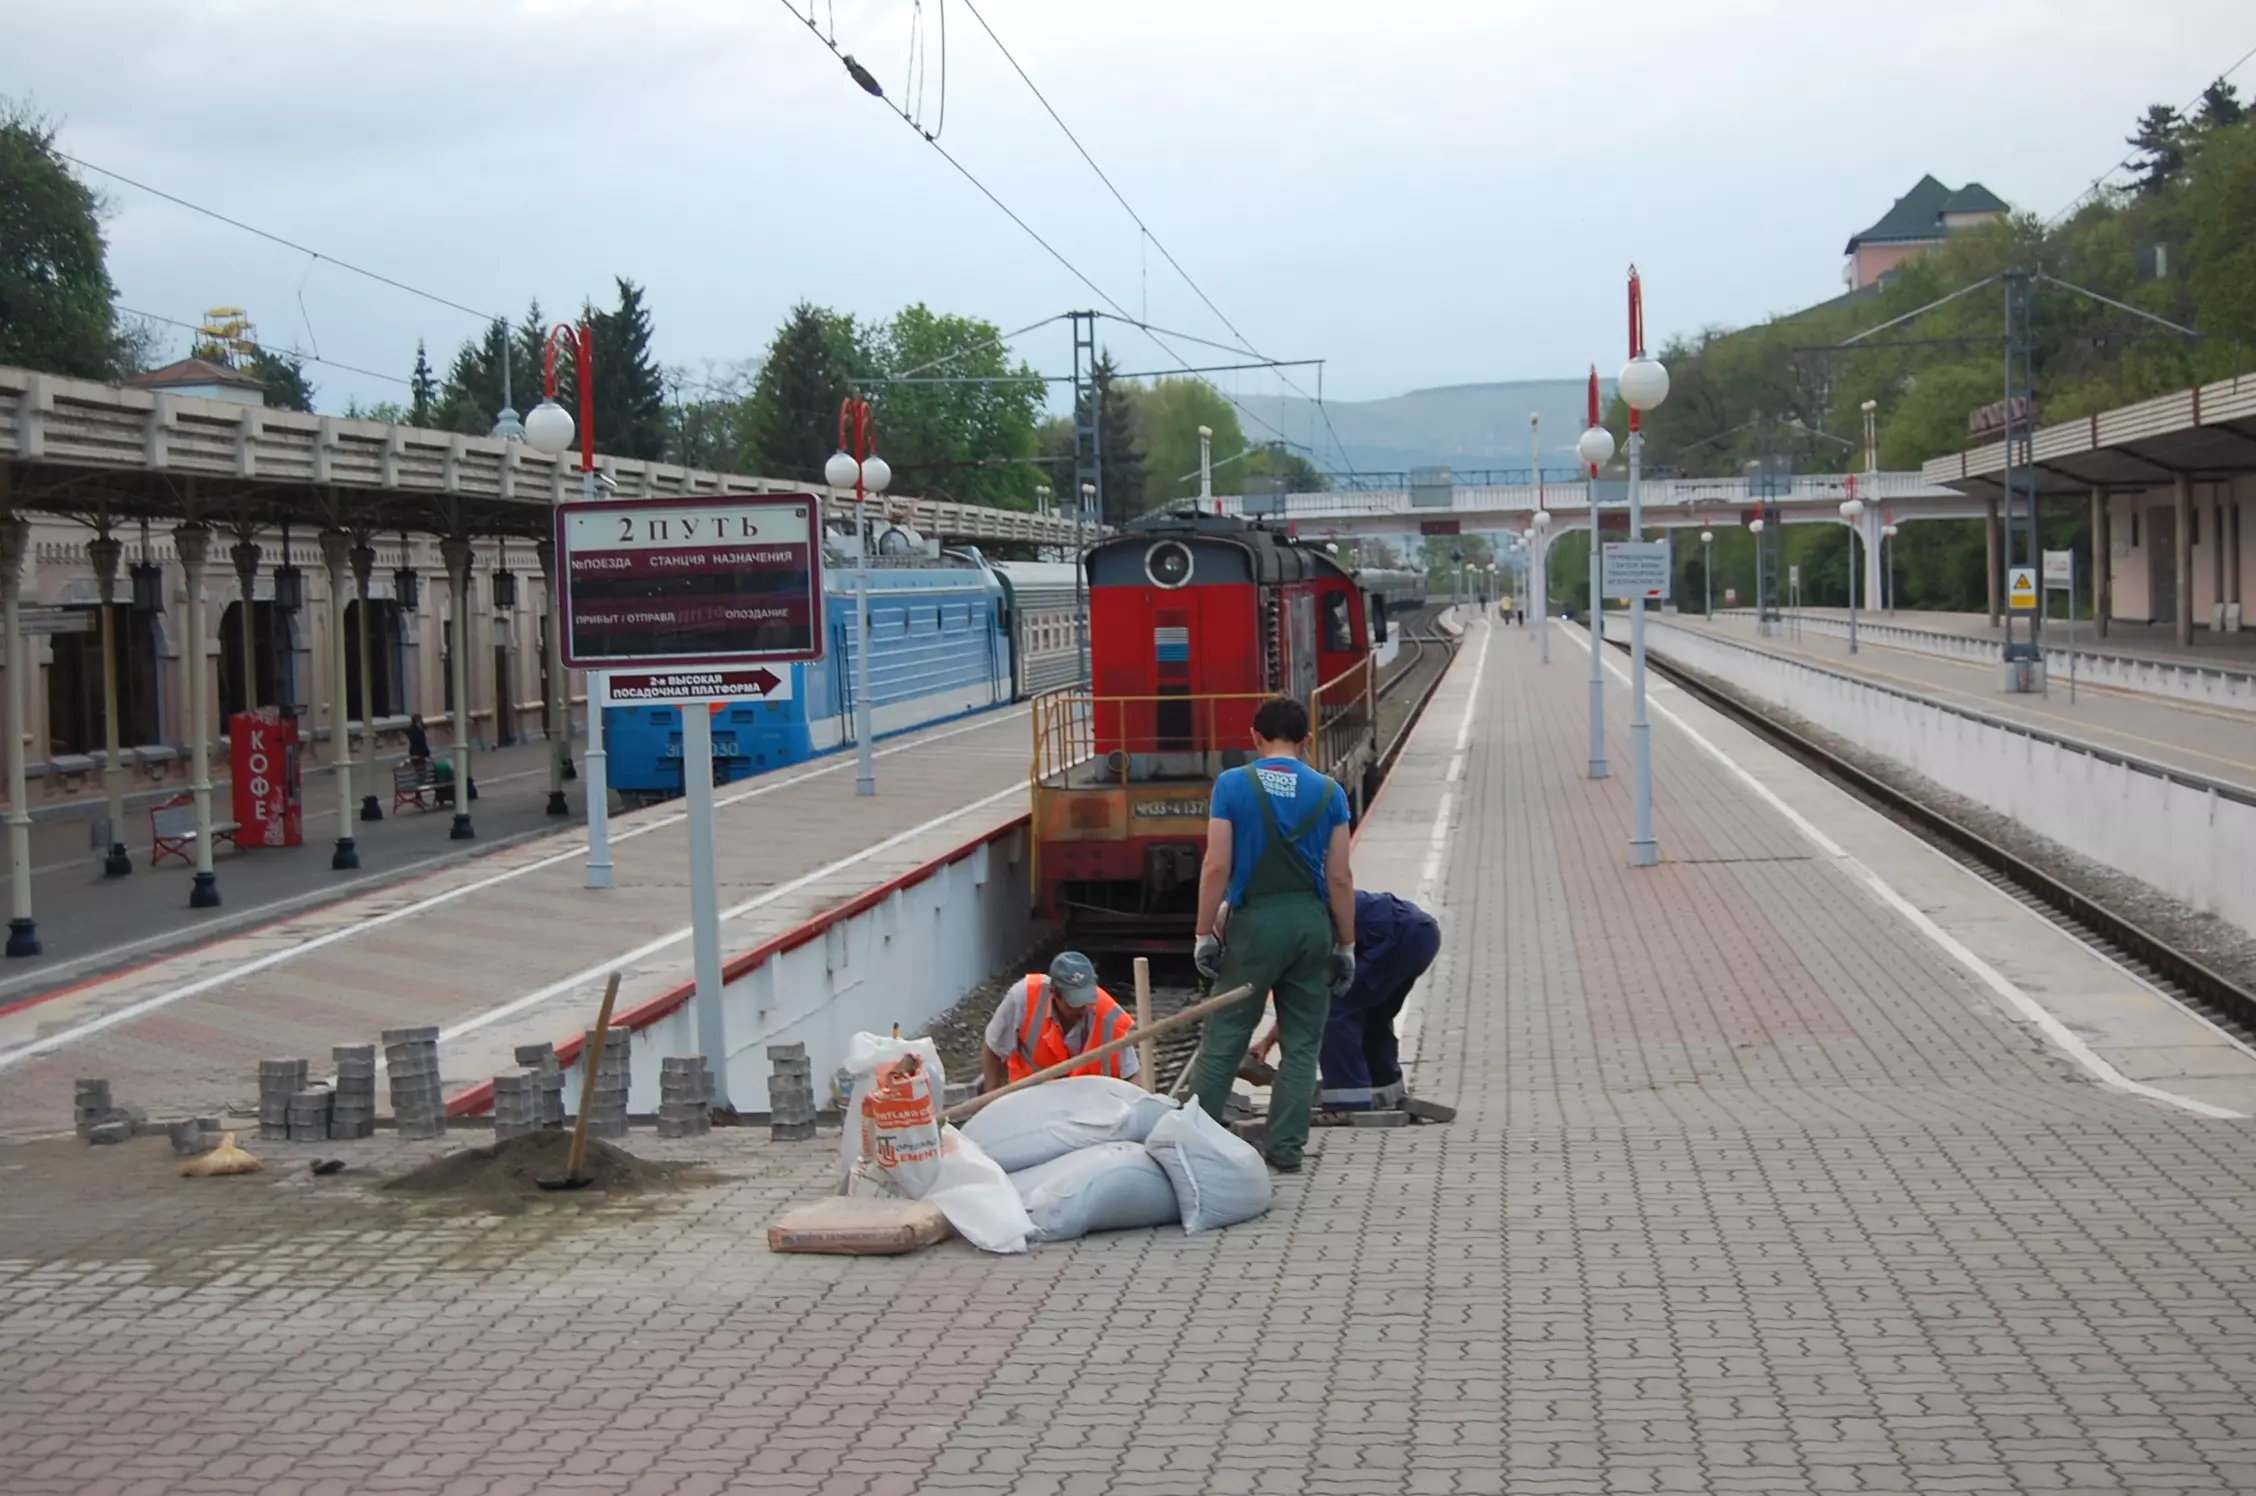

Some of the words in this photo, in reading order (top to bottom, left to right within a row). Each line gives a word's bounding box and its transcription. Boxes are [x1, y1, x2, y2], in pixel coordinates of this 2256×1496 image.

[618, 517, 635, 542] 2
[648, 517, 759, 541] ПУТЬ
[649, 554, 706, 568] СТАНЦИЯ
[712, 551, 793, 565] НАЗНАЧЕНИЯ
[575, 613, 618, 625] ПРИБЫТ
[725, 607, 789, 620] ОПОЗДАНИЕ
[668, 675, 722, 686] ВЫСОКАЯ
[613, 686, 689, 699] ПОСАДОЧНАЯ
[691, 683, 761, 697] ПЛАТФОРМА
[249, 730, 270, 820] КОФЕ
[1258, 771, 1297, 786] СОЮЗ
